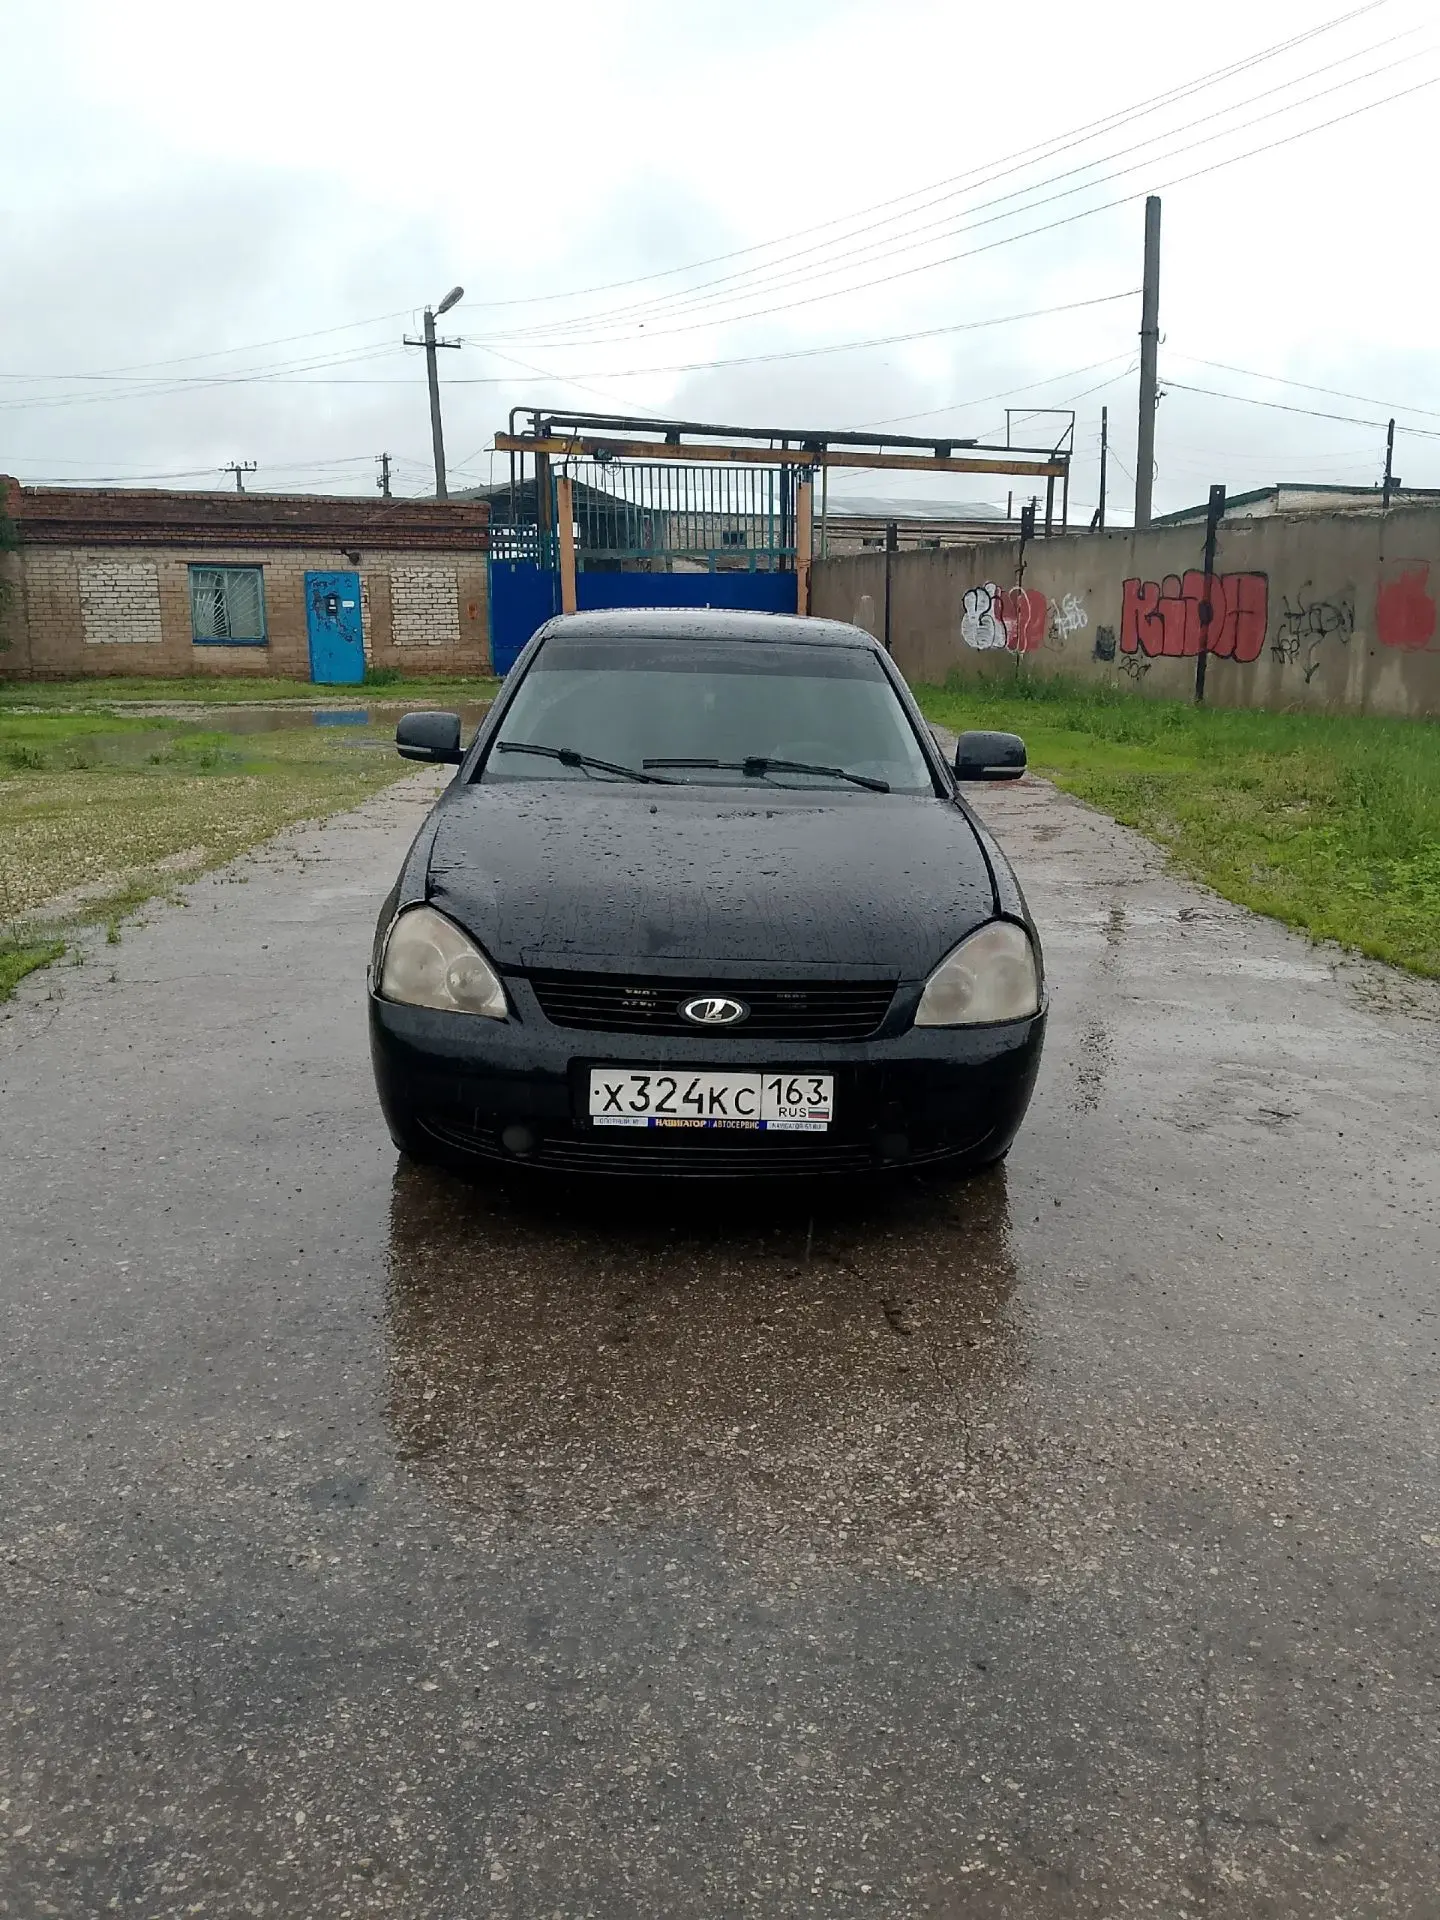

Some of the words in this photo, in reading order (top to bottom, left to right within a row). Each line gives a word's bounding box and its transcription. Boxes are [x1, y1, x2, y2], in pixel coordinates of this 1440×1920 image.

[768, 1078, 824, 1106] 163
[778, 1107, 807, 1118] RUS
[713, 1120, 760, 1130] АВТОСЕРВИС
